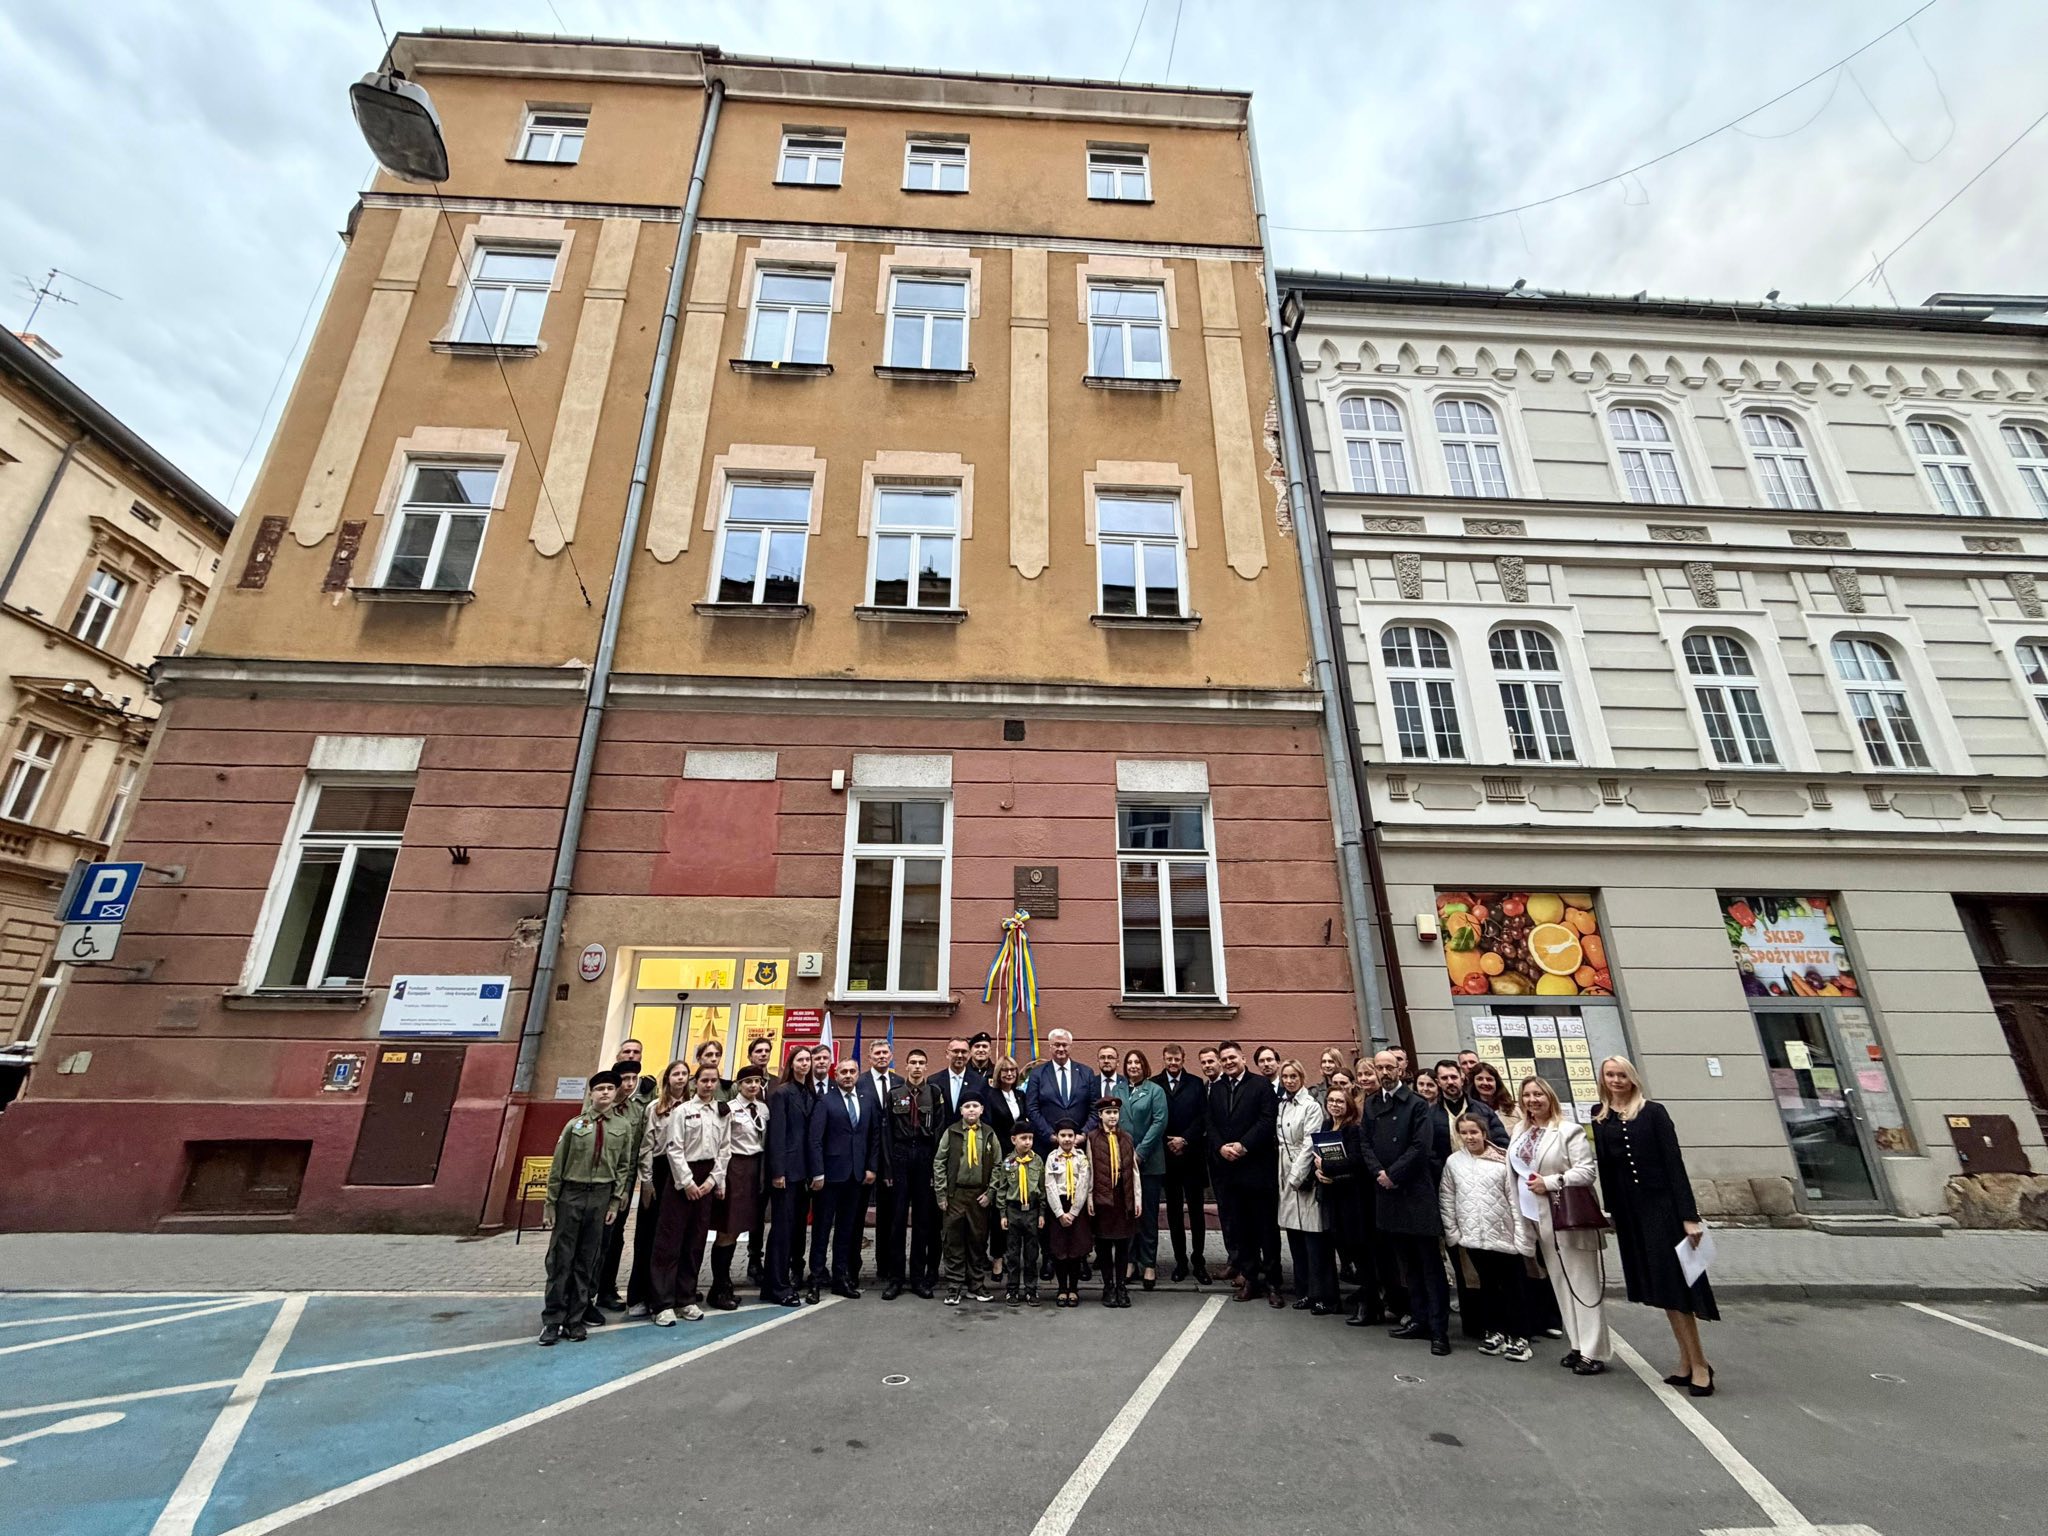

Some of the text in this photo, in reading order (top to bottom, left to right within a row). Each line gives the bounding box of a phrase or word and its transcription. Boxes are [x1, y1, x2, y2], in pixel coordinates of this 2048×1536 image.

[81, 869, 128, 915] P
[1763, 930, 1805, 944] SKLEP
[1749, 947, 1830, 964] SPOŻYWCZY
[805, 955, 814, 970] 3
[1533, 1024, 1554, 1033] 2.99
[1536, 1045, 1557, 1053] 8.99
[1564, 1044, 1587, 1053] 11.99
[1512, 1066, 1533, 1076] 3,99
[1570, 1066, 1590, 1077] 3,99
[1573, 1088, 1596, 1098] 19,99
